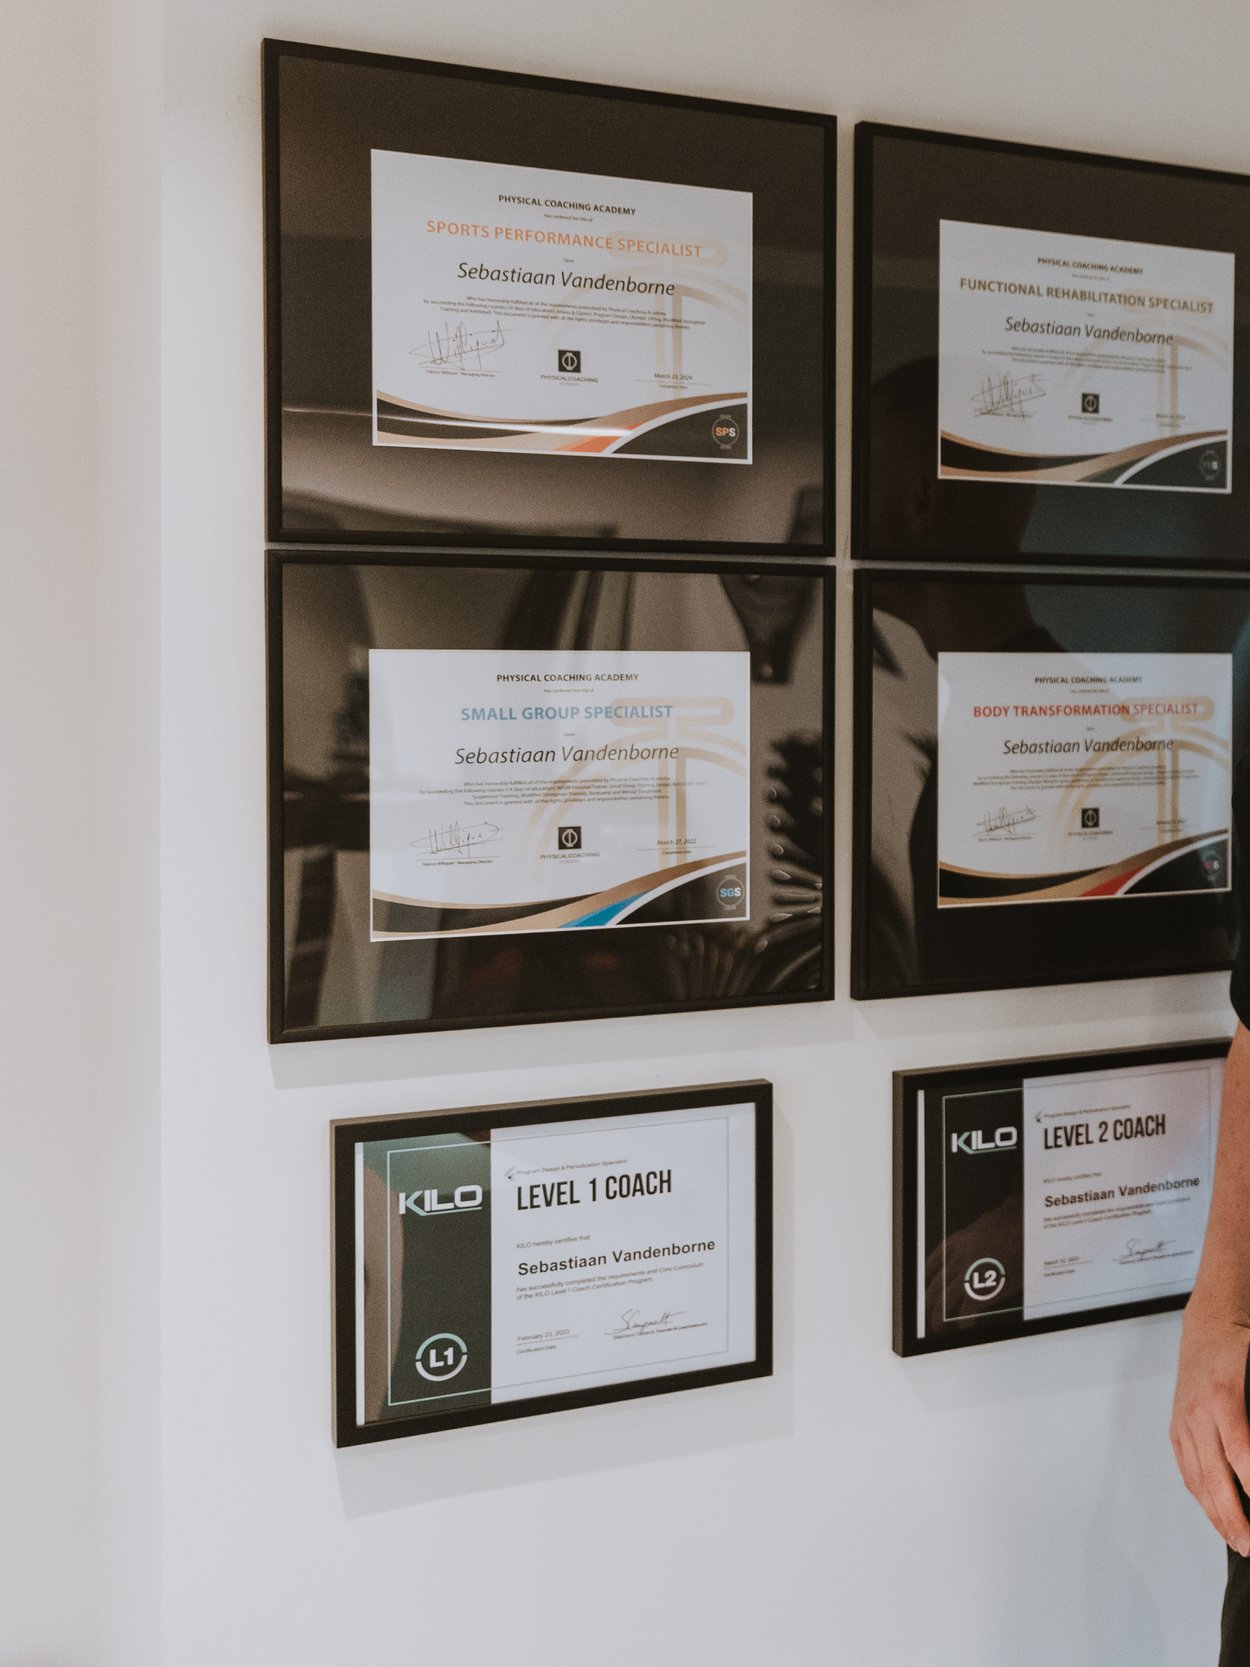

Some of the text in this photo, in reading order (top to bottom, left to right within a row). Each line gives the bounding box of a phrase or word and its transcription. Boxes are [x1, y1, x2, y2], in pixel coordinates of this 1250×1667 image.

[498, 194, 636, 216] PHYSICAL COACHING ACADEMY
[426, 220, 702, 258] SPORTS PERFORMANCE SPECIALIST
[1037, 257, 1143, 275] PHYSICAL COACHING ACADEMY
[457, 262, 675, 296] Sebastiaan Vandenborne
[960, 277, 1214, 314] FUNCTIONAL REHABILITATION SPECIALIST
[1005, 317, 1173, 346] Sebastiaan Vandenborne
[715, 426, 736, 437] SPS
[496, 673, 638, 682] PHYSICAL COACHING ACADEMY
[1034, 676, 1069, 684] PHYSICAL
[1071, 676, 1108, 684] COACHING
[461, 705, 673, 721] SMALL GROUP SPECIALIST
[973, 703, 1199, 718] BODY TRANSFORMATION SPECIALIST
[455, 744, 680, 765] Sebastiaan Vandenborne
[1003, 737, 1173, 755] Sebastiaan Vandenborne
[720, 887, 742, 897] SGS
[952, 1127, 1018, 1154] KILO
[1044, 1113, 1166, 1150] LEVEL 2 COACH
[399, 1184, 483, 1216] KILO
[517, 1169, 671, 1210] LEVEL 1 COACH
[1044, 1177, 1200, 1208] Sebastiaan Vandenborne
[518, 1240, 715, 1276] Sebastiaan Vandenborne
[973, 1271, 996, 1289] L2
[430, 1347, 454, 1368] L1
